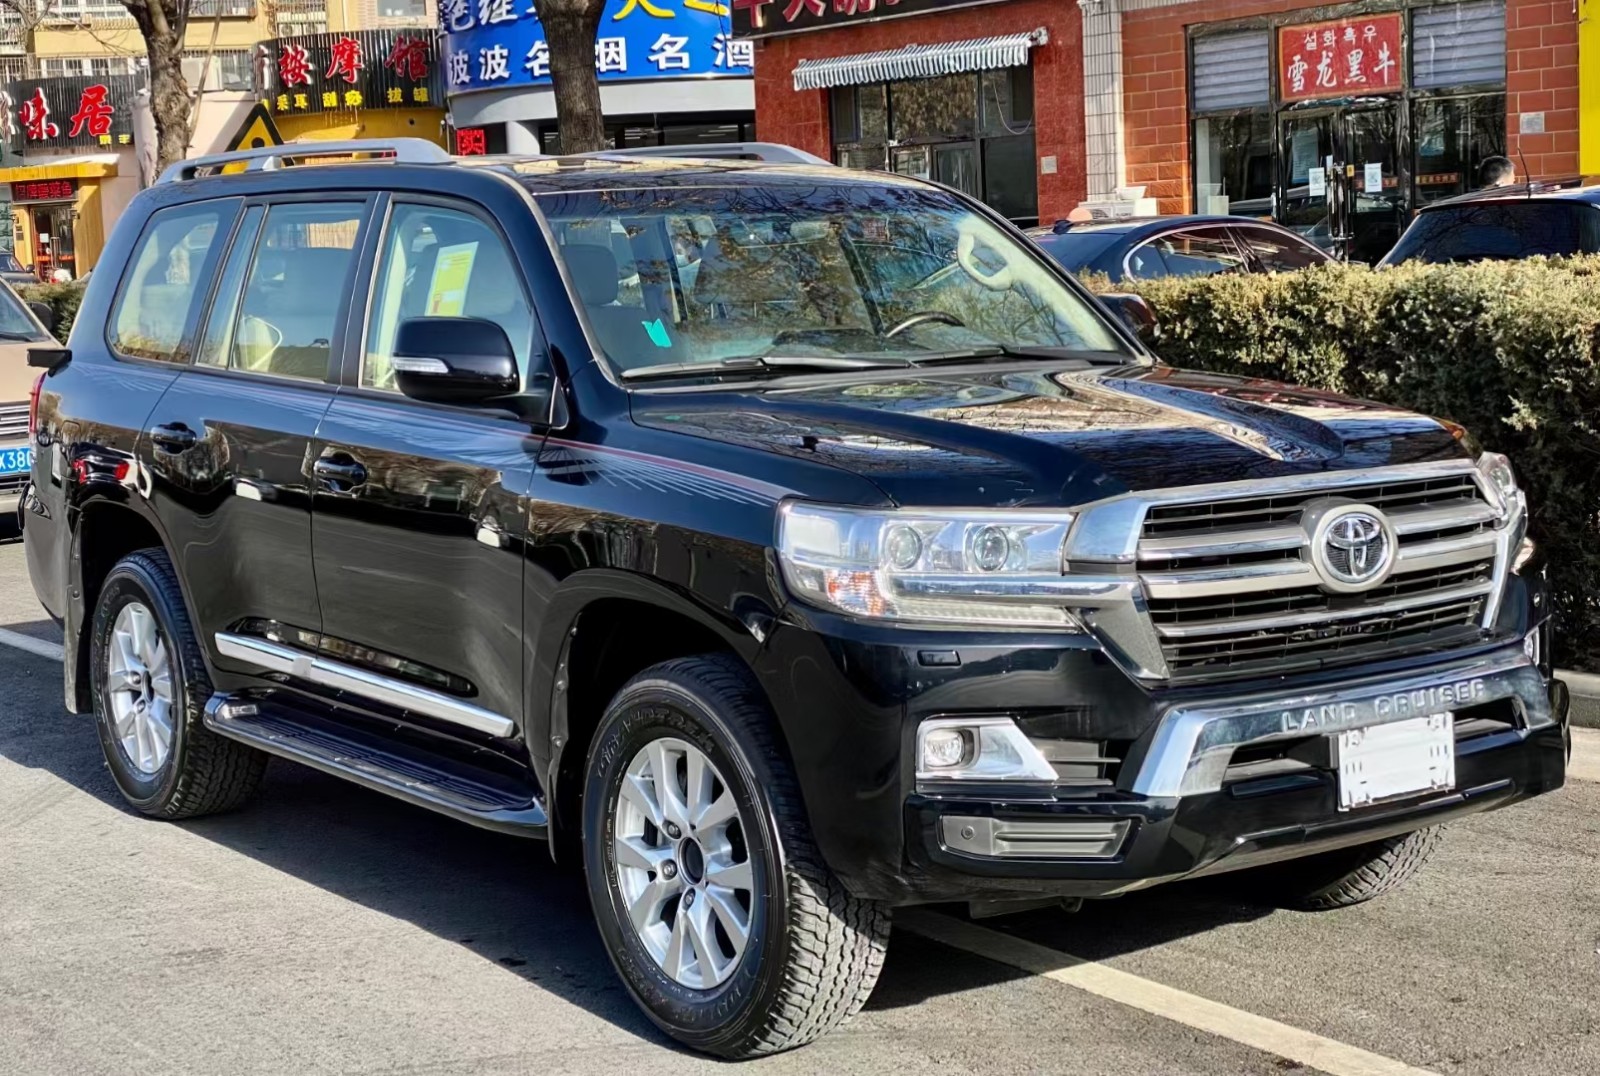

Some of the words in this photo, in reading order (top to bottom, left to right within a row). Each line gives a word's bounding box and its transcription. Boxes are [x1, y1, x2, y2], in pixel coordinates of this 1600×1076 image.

[278, 35, 431, 88] 按摩馆
[1288, 41, 1395, 92] 雪龙黑牛
[19, 84, 114, 140] 味居
[1281, 704, 1356, 732] LAND
[1375, 678, 1485, 717] CRUISER
